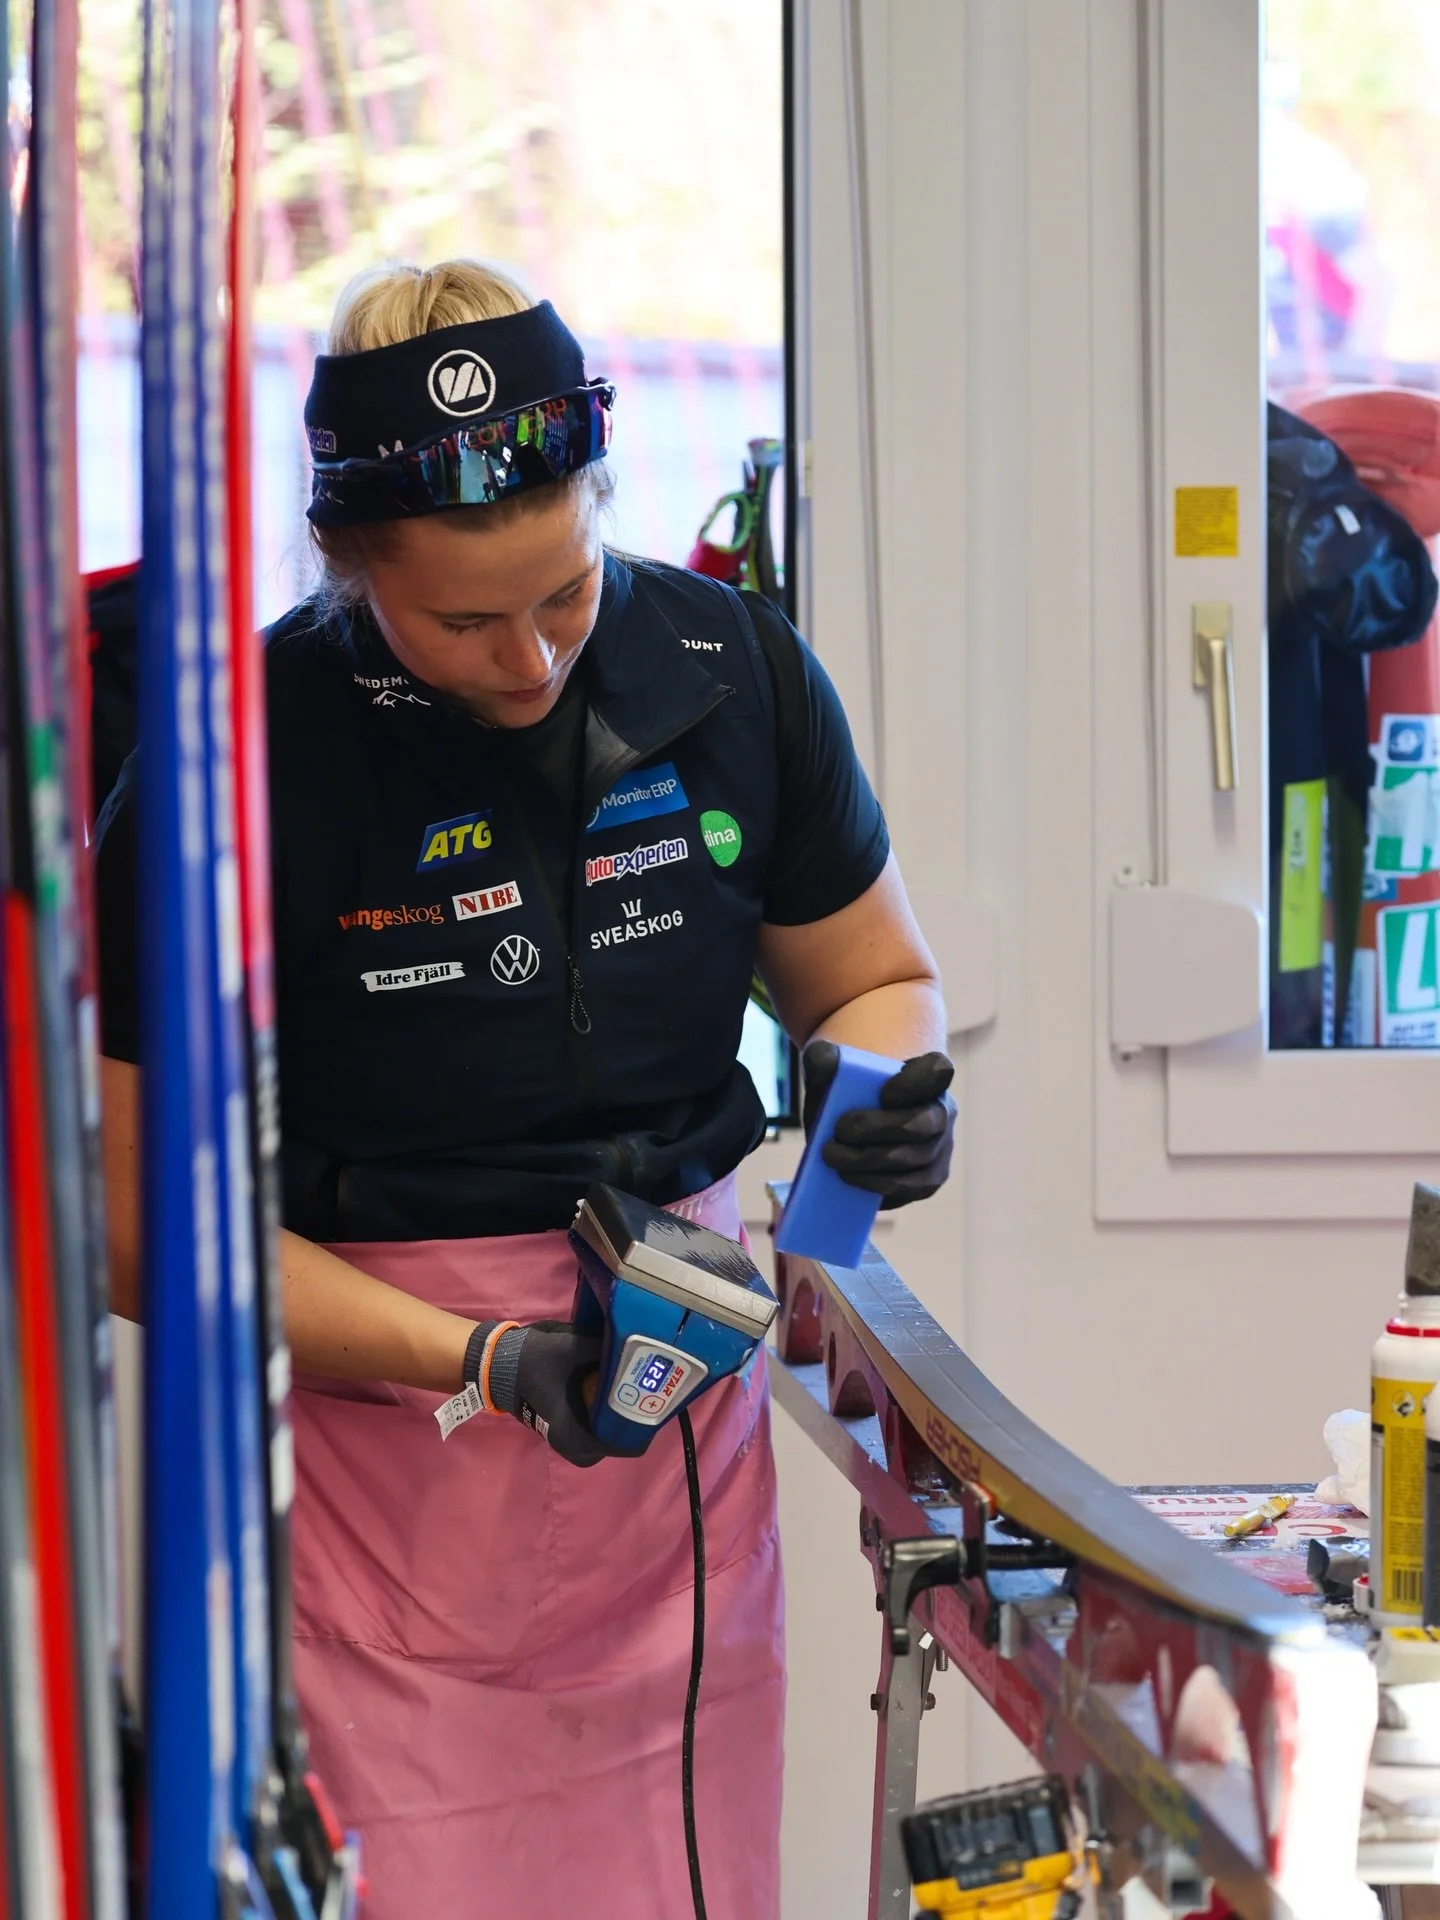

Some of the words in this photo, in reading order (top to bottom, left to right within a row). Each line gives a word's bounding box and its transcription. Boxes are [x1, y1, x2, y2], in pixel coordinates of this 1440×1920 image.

[353, 672, 410, 689] SWEDEM
[422, 820, 493, 863] ATG
[457, 885, 519, 916] NIBE
[590, 909, 684, 950] SVEASKOG
[375, 973, 411, 986] Idre
[413, 964, 451, 984] Fjäll
[642, 1361, 666, 1389] 125
[663, 1365, 684, 1397] STAR
